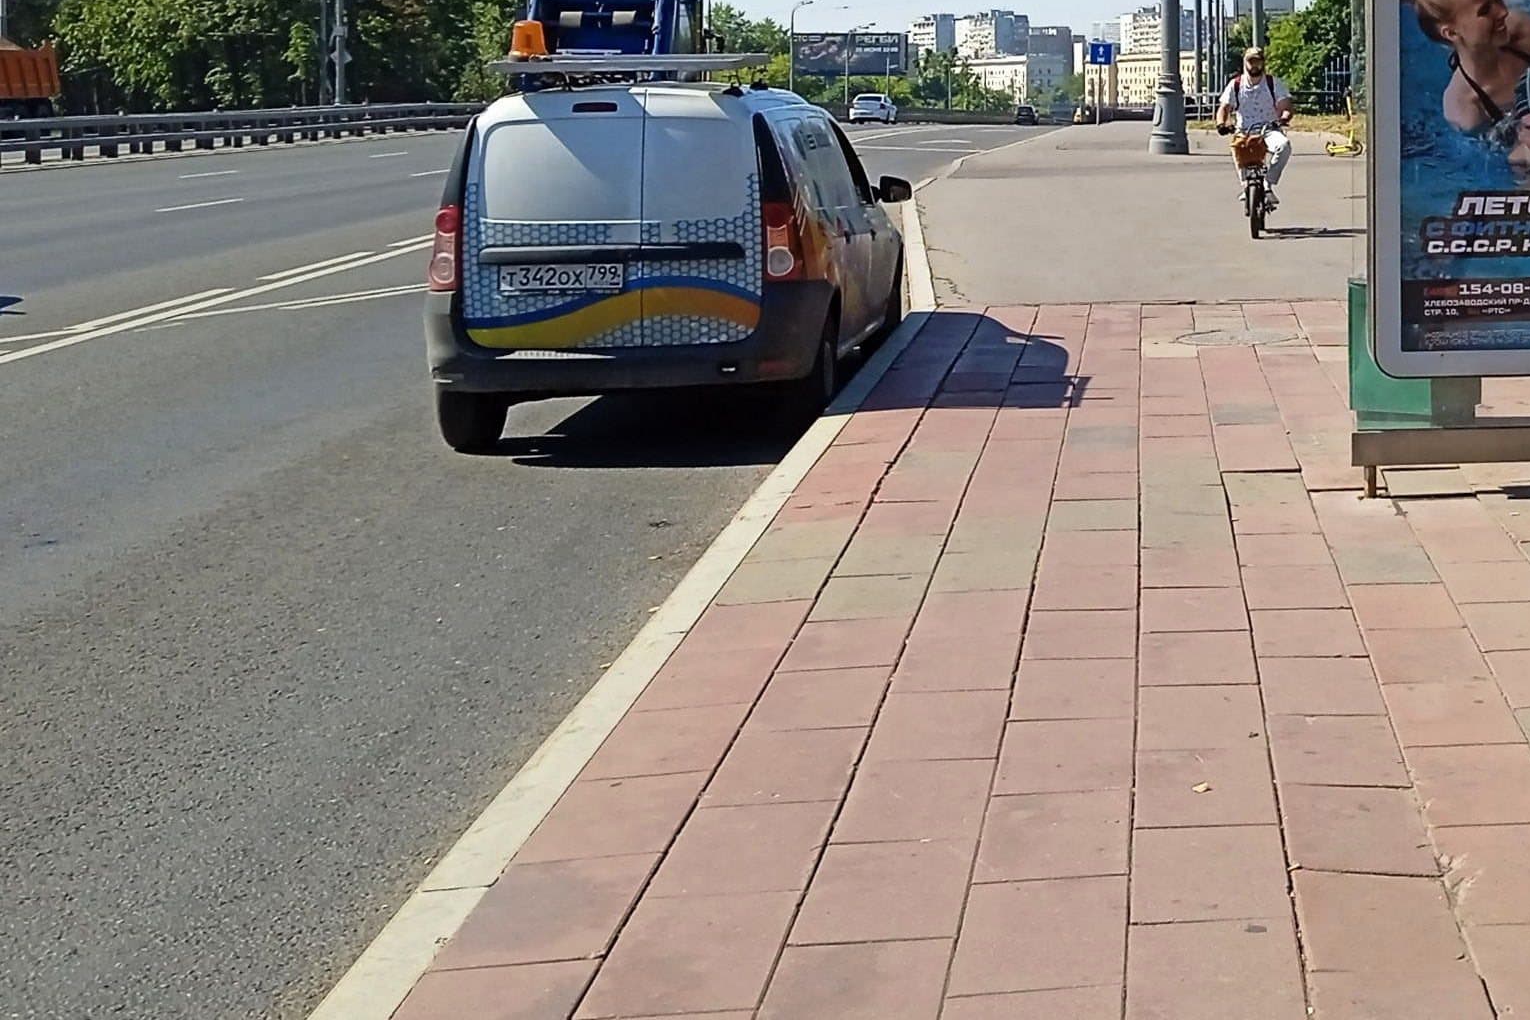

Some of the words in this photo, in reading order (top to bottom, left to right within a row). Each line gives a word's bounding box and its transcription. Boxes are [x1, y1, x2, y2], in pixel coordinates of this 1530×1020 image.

[855, 35, 899, 44] РЕГБИ
[1426, 220, 1446, 237] С
[1426, 239, 1518, 254] С.С.С.Р.
[586, 264, 620, 281] 799
[1423, 298, 1507, 308] ХЛЕБОЗАВОДСКИЙ
